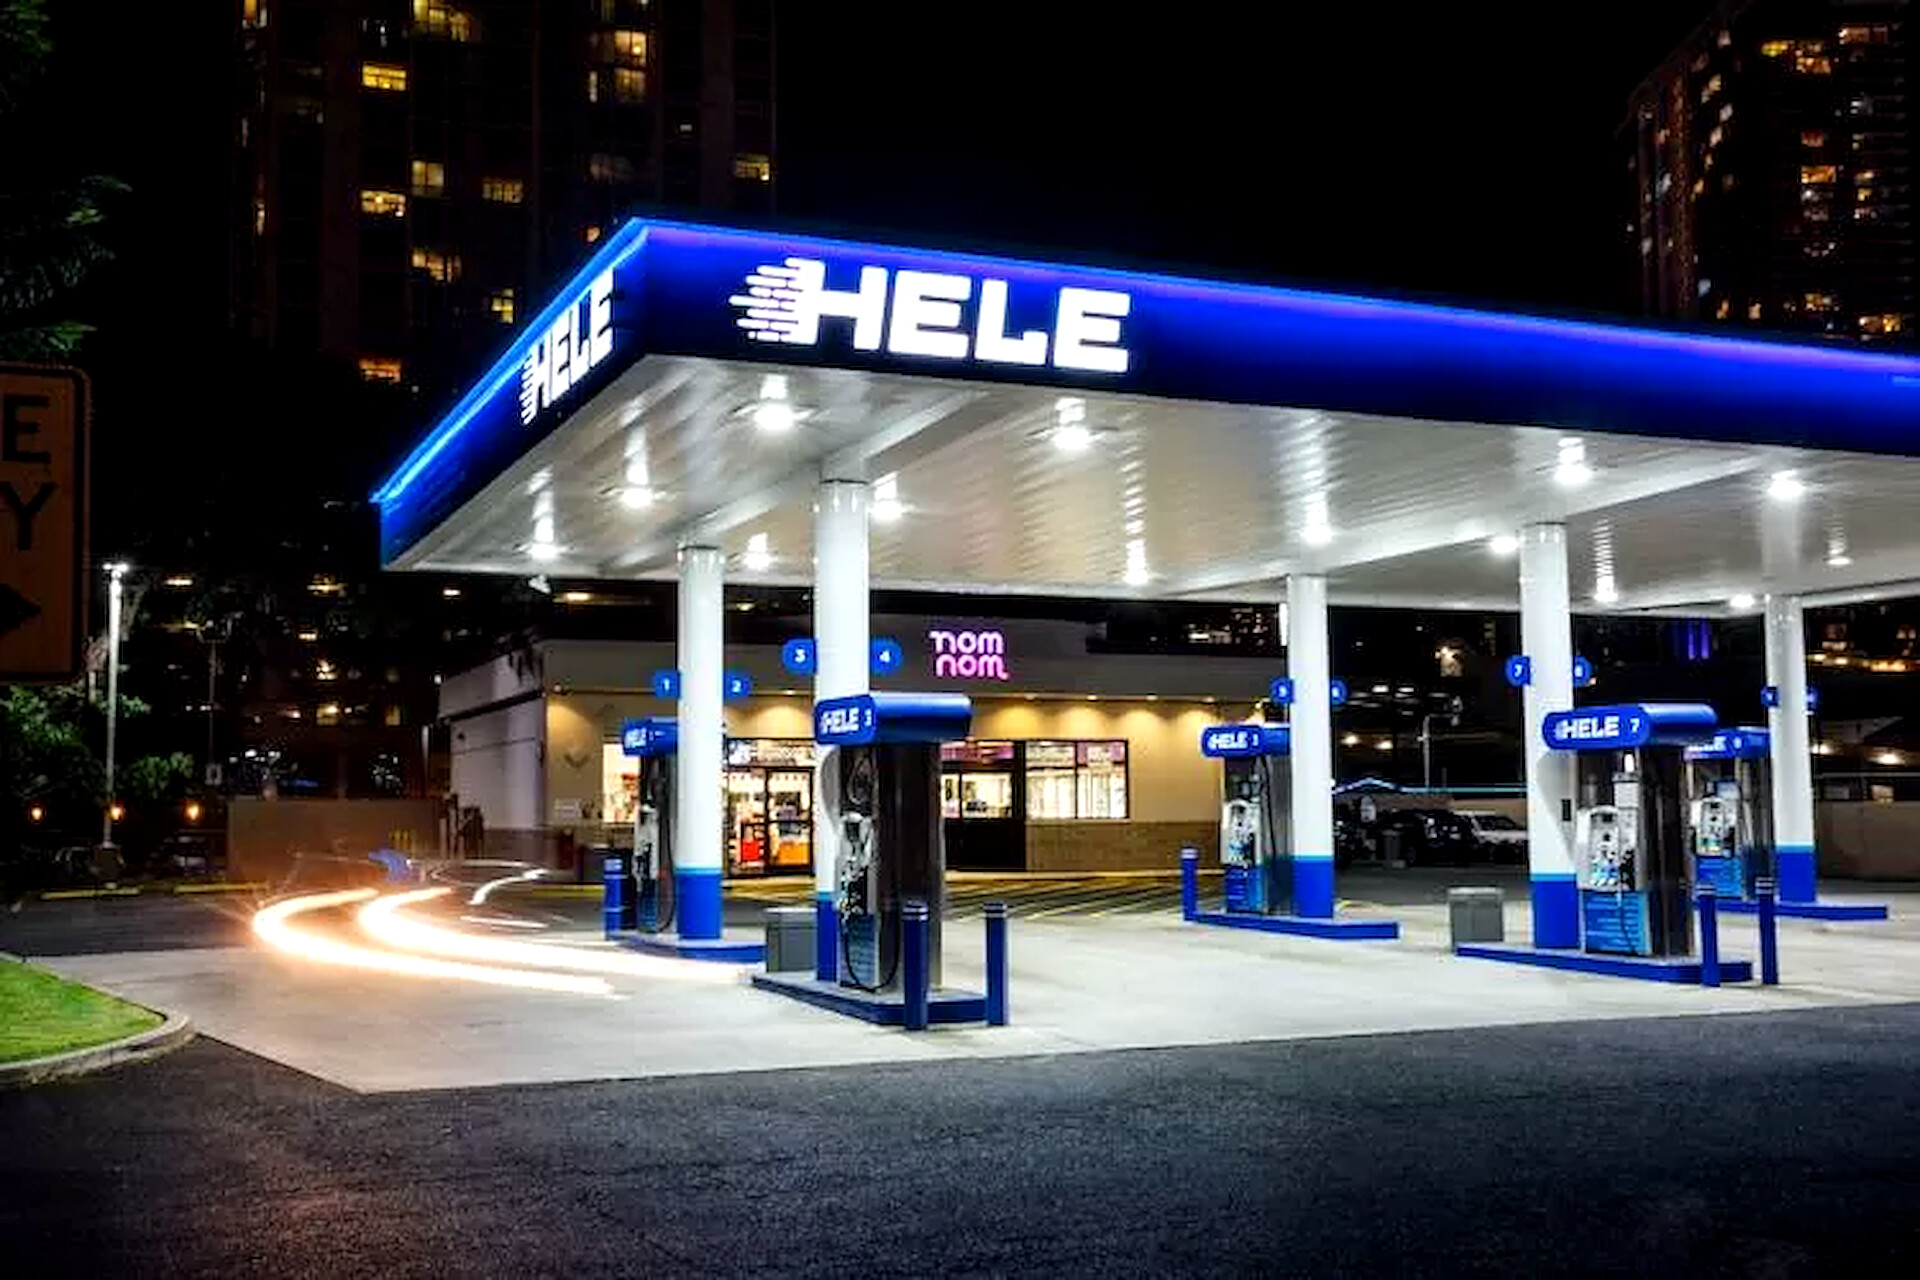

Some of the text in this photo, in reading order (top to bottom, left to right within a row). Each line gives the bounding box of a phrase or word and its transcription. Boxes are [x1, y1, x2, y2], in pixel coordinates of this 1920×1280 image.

[729, 257, 1131, 373] HELE
[519, 267, 614, 425] HELE
[2, 394, 51, 463] E
[0, 481, 56, 551] Y
[929, 631, 1004, 654] nom
[794, 648, 806, 664] 3
[879, 650, 891, 664] 4
[936, 653, 1009, 680] nom
[662, 678, 671, 693] 1
[730, 679, 742, 694] 2
[1554, 715, 1641, 741] HELE 7
